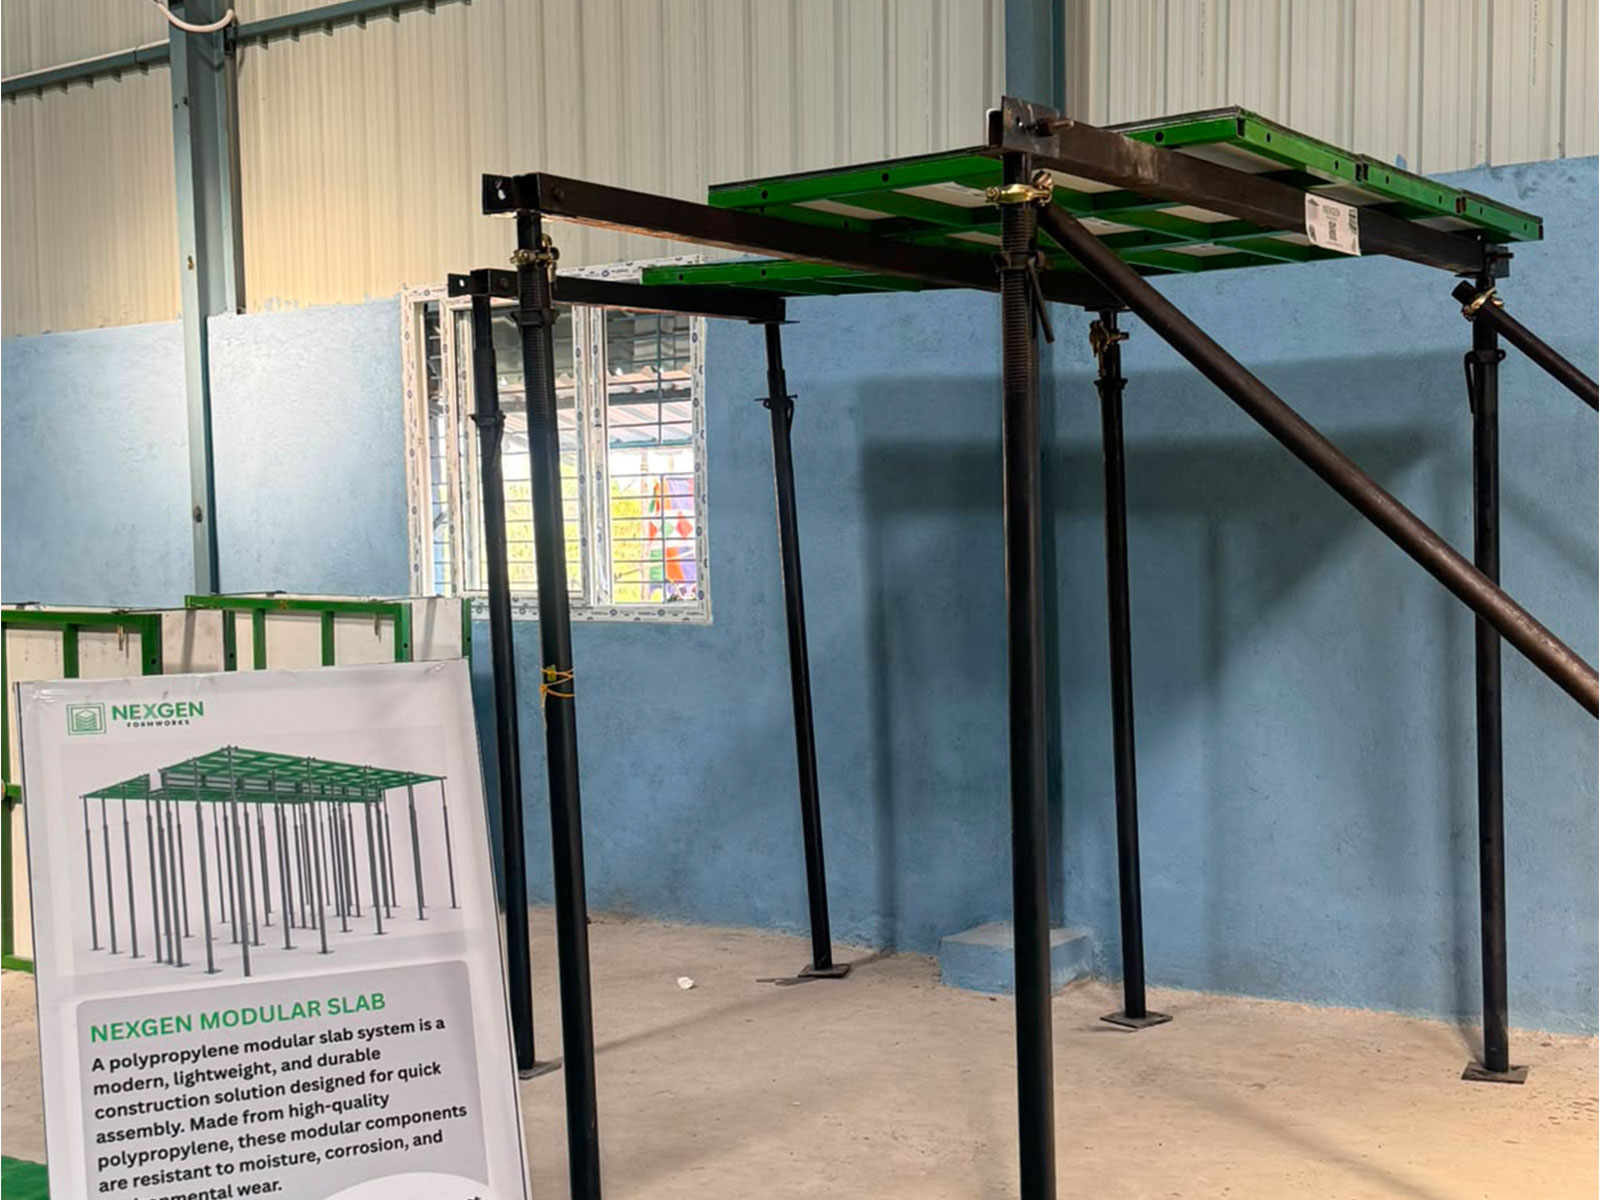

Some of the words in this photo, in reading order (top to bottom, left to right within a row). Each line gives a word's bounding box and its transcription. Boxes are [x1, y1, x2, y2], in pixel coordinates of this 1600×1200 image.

[112, 701, 204, 720] NEXGEN
[91, 1015, 191, 1042] NEXGEN
[201, 1001, 321, 1029] MODULAR
[328, 993, 385, 1015] SLAB
[92, 1057, 105, 1072] A
[110, 1045, 239, 1073] polypropylene
[244, 1034, 315, 1053] modular
[320, 1028, 353, 1044] slab
[358, 1023, 415, 1041] system
[419, 1019, 432, 1031] is
[436, 1020, 445, 1029] a
[94, 1077, 169, 1095] modern,
[174, 1062, 276, 1087] lightweight,
[281, 1055, 312, 1071] and
[317, 1048, 380, 1067] durable
[95, 1094, 210, 1119] construction
[215, 1085, 285, 1104] solution
[290, 1071, 365, 1093] designed
[370, 1069, 393, 1083] for
[398, 1062, 441, 1082] quick
[97, 1121, 184, 1144] assembly.
[190, 1113, 238, 1131] Made
[243, 1109, 283, 1124] from
[289, 1093, 389, 1119] high-quality
[98, 1140, 233, 1172] polypropylene,
[238, 1132, 286, 1148] these
[291, 1121, 361, 1141] modular
[366, 1106, 467, 1130] components
[99, 1179, 128, 1192] are
[133, 1165, 211, 1187] resistant
[216, 1164, 234, 1175] to
[240, 1152, 320, 1172] moisture,
[325, 1138, 409, 1159] corrosion,
[413, 1129, 442, 1146] and
[237, 1181, 282, 1196] wear.
